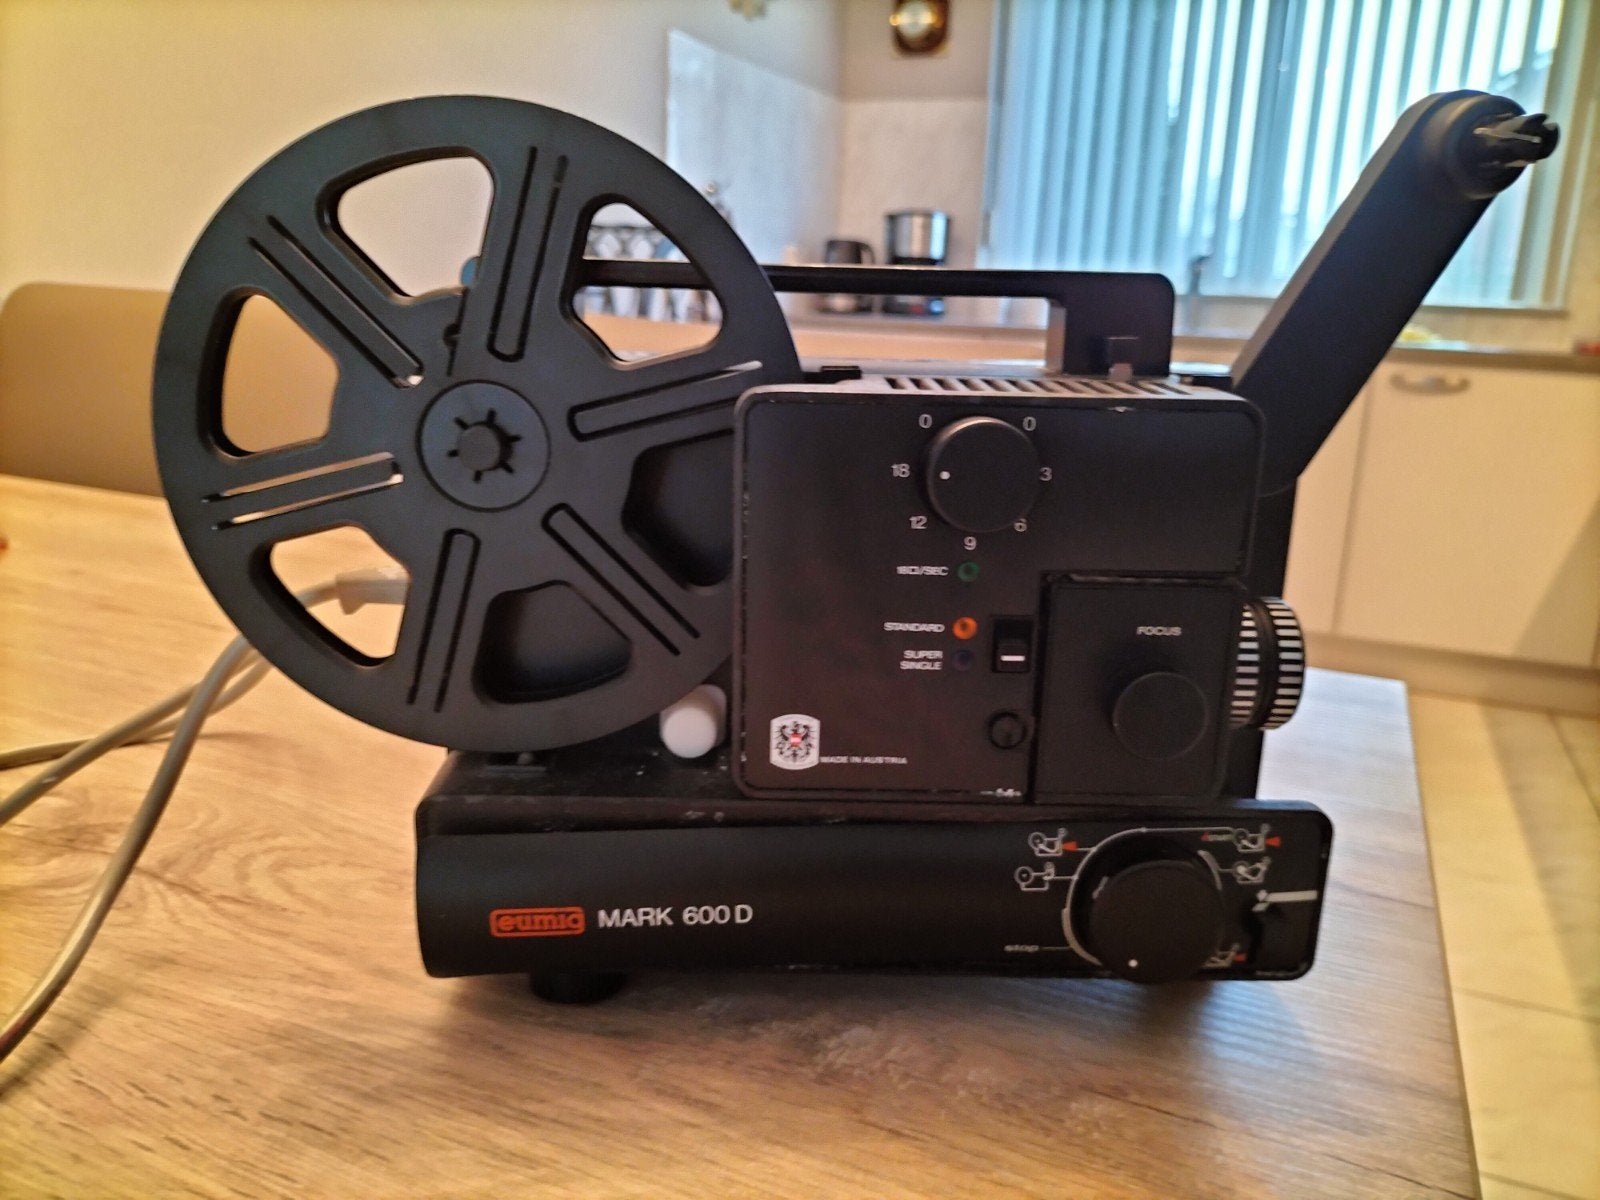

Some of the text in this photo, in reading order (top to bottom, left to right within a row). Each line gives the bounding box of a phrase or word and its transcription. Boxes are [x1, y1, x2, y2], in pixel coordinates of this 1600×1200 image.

[918, 413, 933, 429] 0
[1022, 416, 1037, 431] 0
[891, 463, 911, 478] 18
[1039, 467, 1054, 482] 3
[909, 515, 928, 530] 12
[1014, 518, 1028, 532] 6
[963, 536, 977, 550] 9
[883, 622, 946, 633] STANDARD
[1136, 626, 1182, 636] FOCUS
[903, 650, 943, 659] SUPER
[900, 660, 943, 670] SINGLE
[820, 755, 848, 763] MADE
[862, 756, 908, 764] AUSTRIA
[598, 904, 753, 928] MARK 600 D
